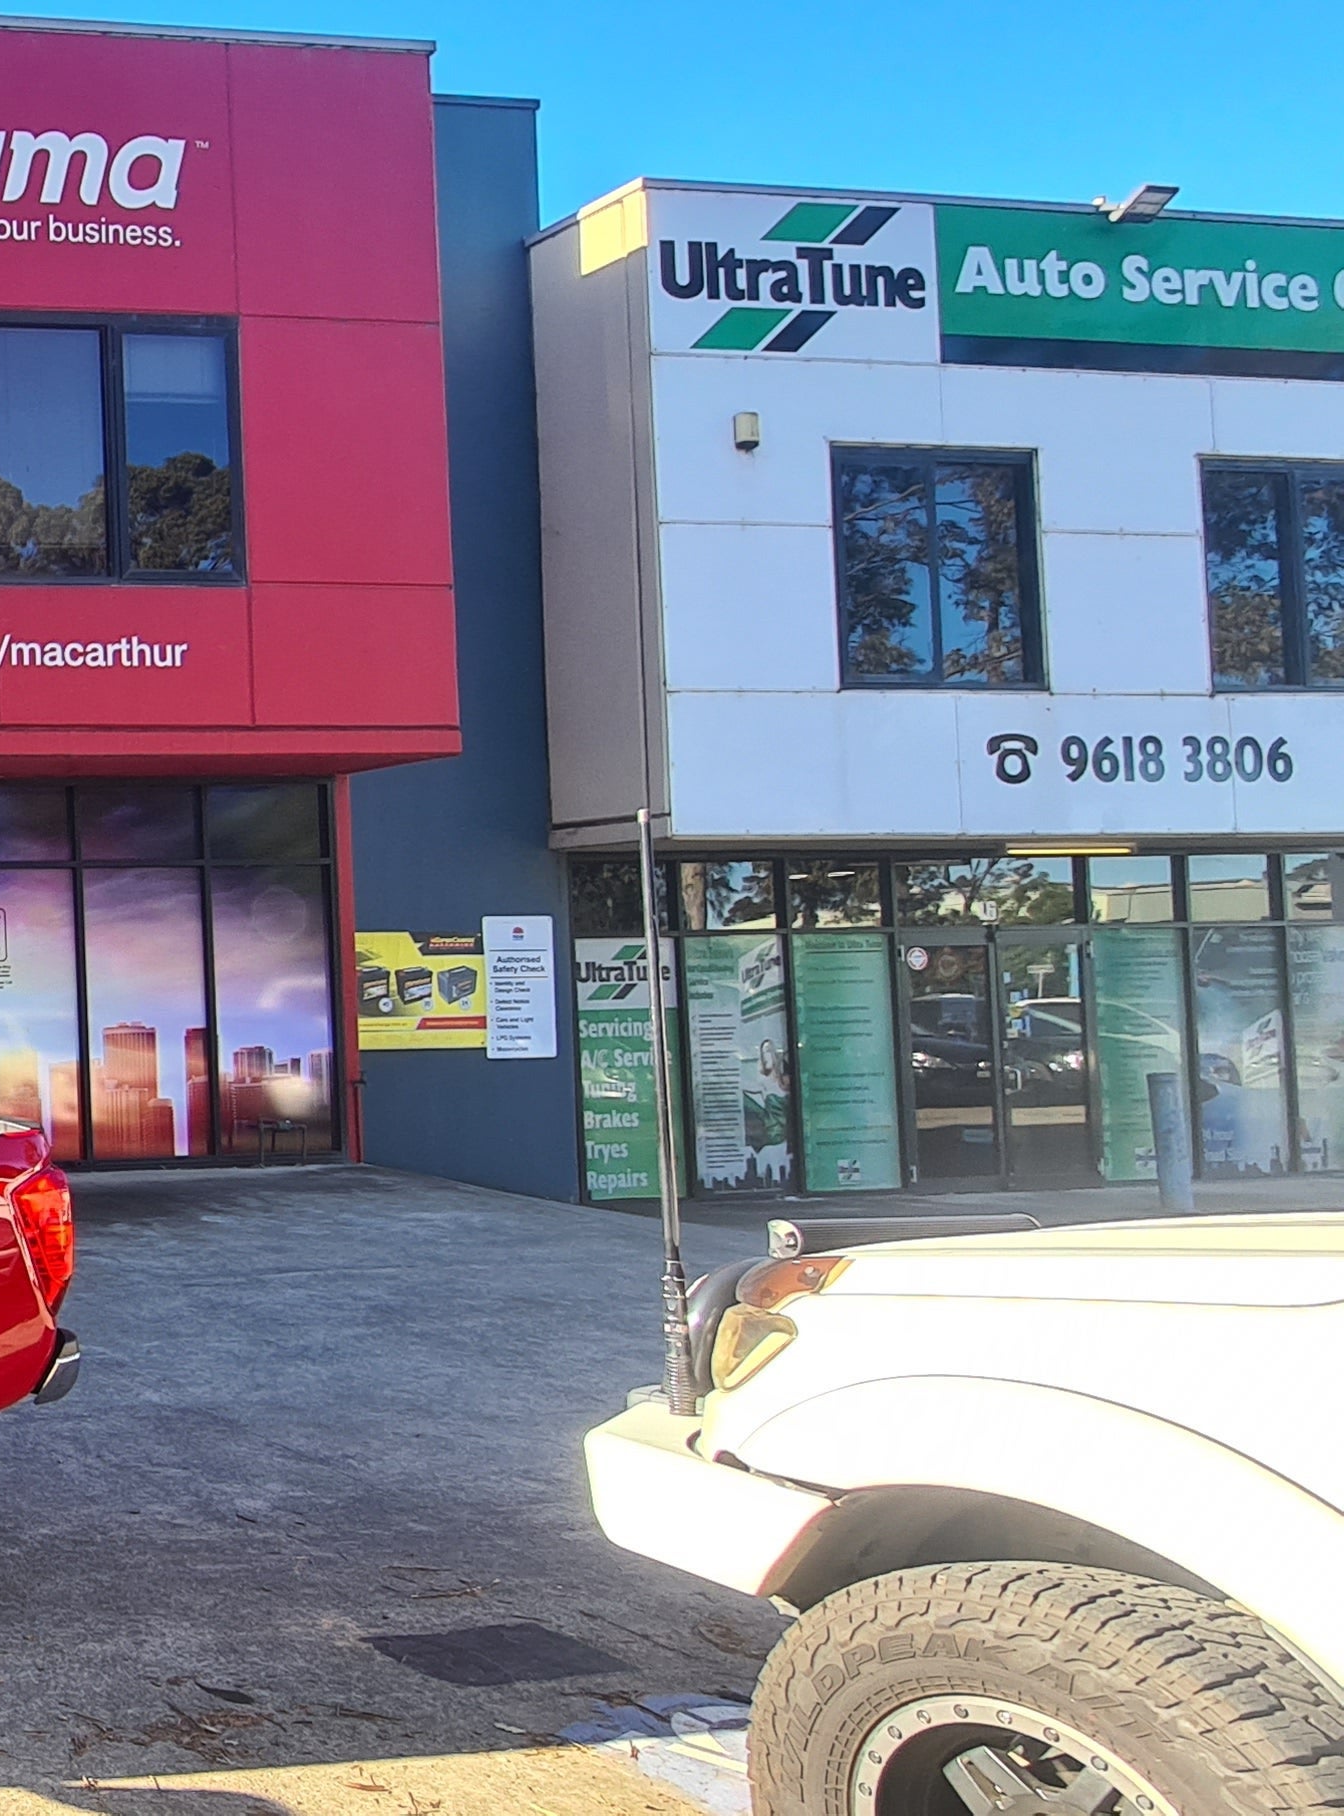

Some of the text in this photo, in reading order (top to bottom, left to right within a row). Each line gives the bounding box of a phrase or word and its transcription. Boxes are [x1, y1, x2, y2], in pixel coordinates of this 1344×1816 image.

[48, 214, 181, 248] business.
[660, 240, 926, 310] UltraTune
[955, 246, 1105, 299] Auto
[1122, 255, 1319, 312] Service
[1060, 734, 1294, 783] 9618 3806
[493, 965, 545, 974] Safety Check
[496, 956, 541, 964] Authorised
[575, 961, 671, 983] UltraTue
[579, 1018, 654, 1041] Servicing
[581, 1049, 609, 1070] A/C
[584, 1110, 640, 1129] Brakes
[585, 1141, 629, 1164] Tryes
[587, 1168, 648, 1194] Repairs
